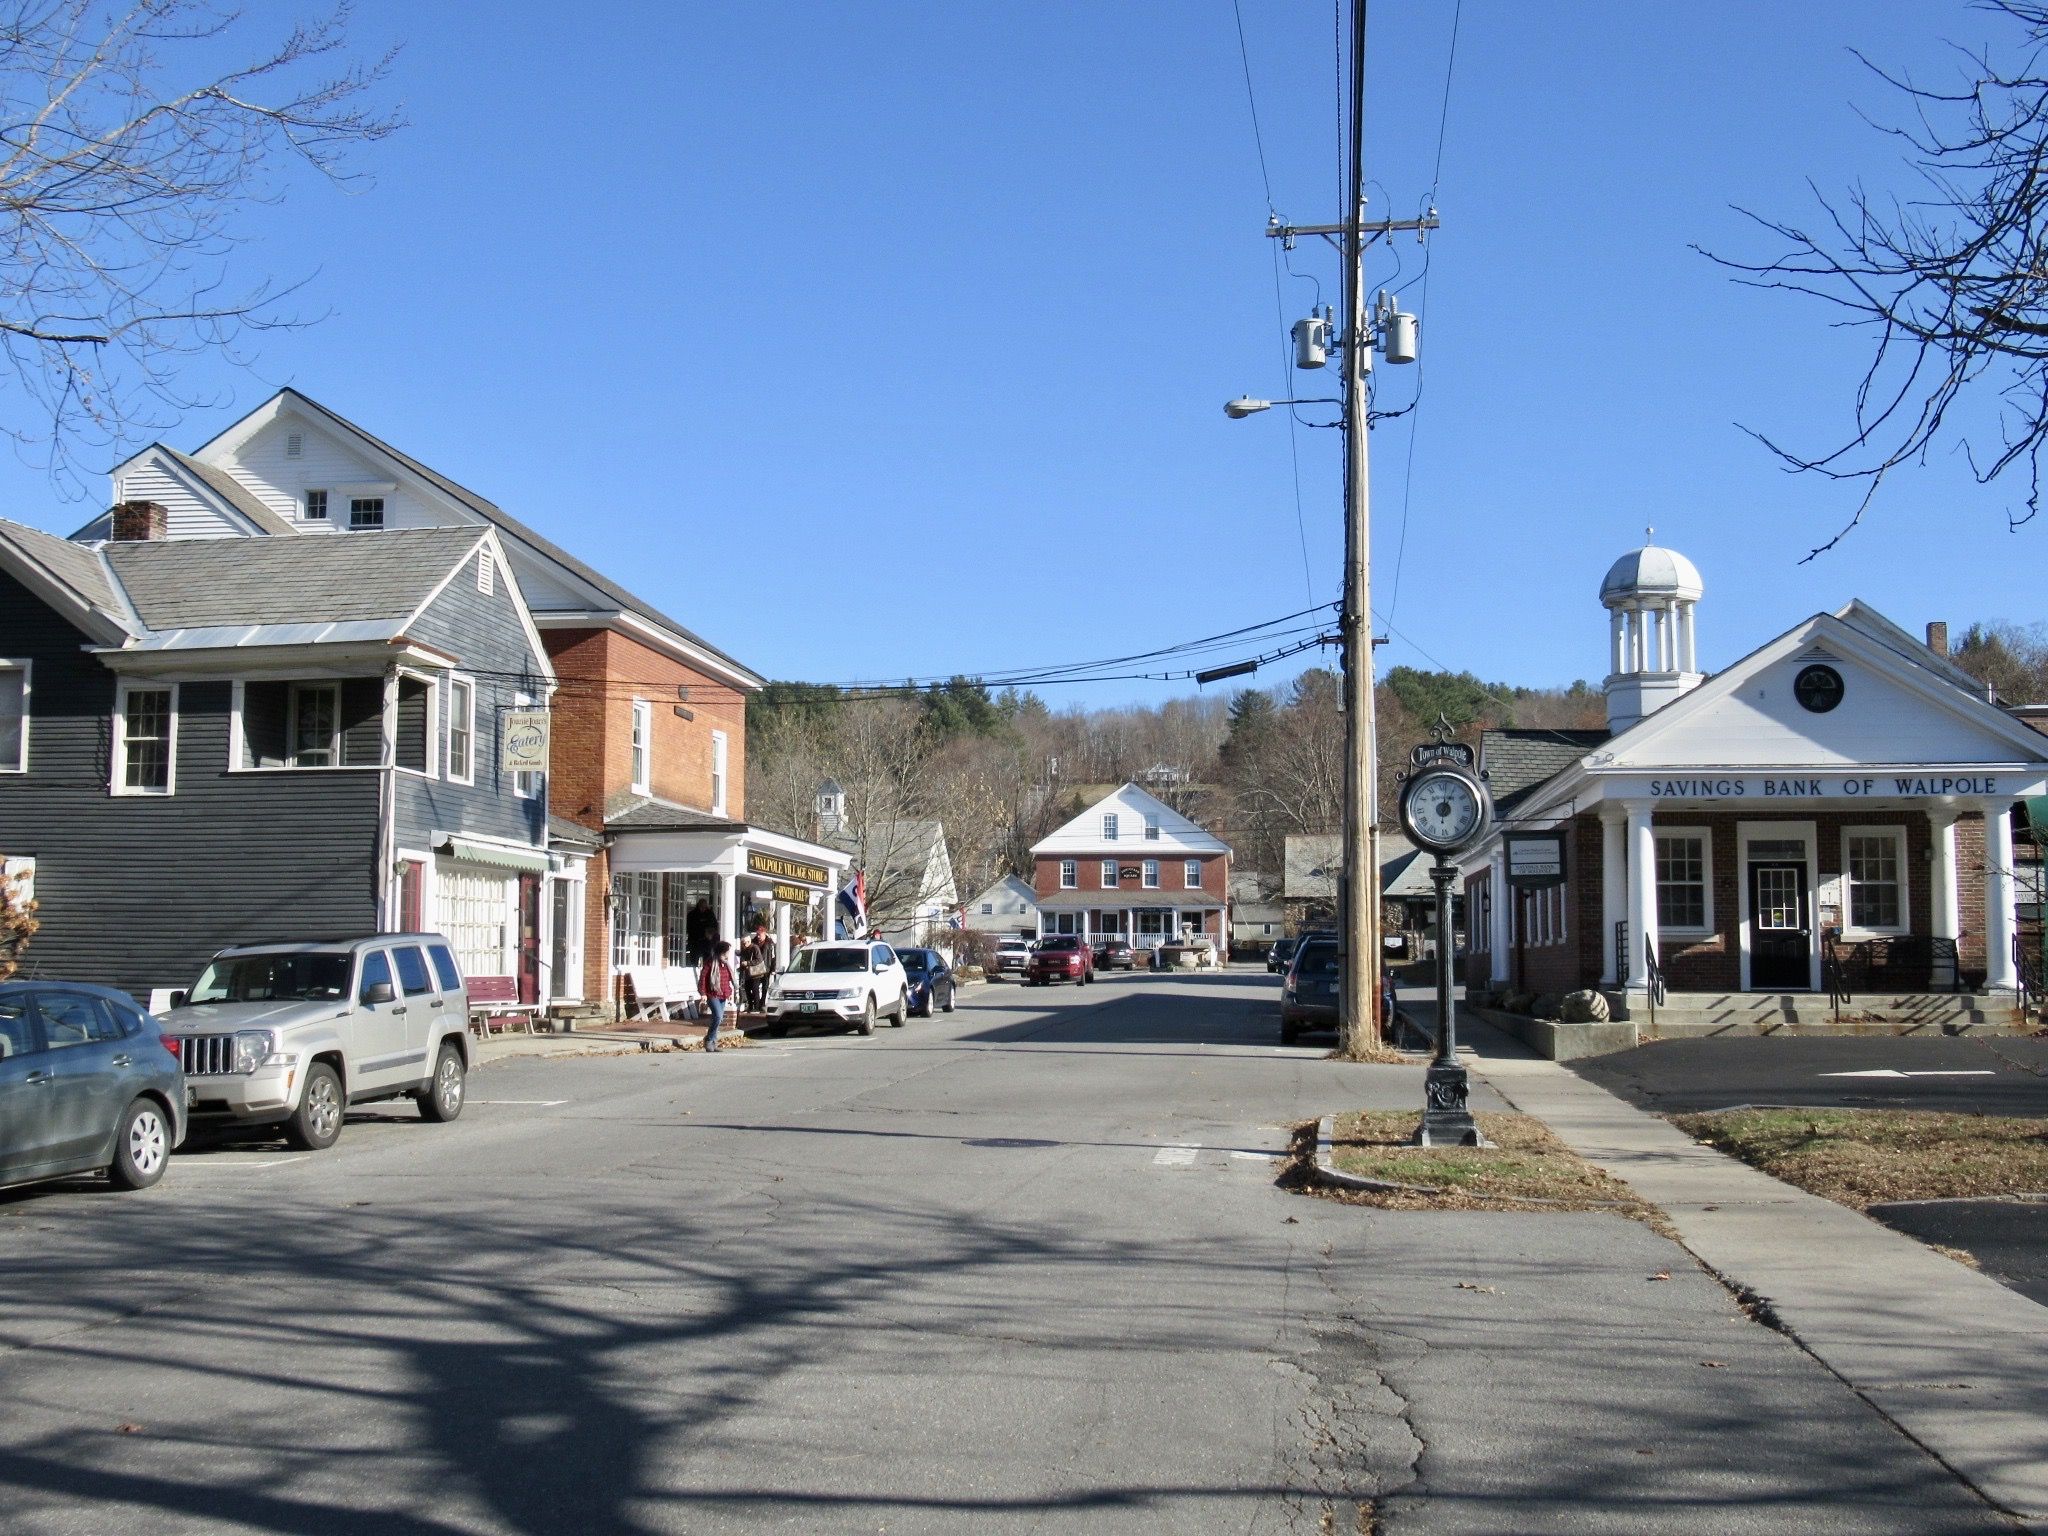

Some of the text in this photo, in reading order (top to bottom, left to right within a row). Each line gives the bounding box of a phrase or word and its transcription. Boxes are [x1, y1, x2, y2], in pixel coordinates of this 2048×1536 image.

[507, 735, 545, 754] Eatery
[1418, 746, 1467, 761] Town of Walpole
[1651, 778, 1996, 796] SAVINGS BANK OF WALPOLE
[754, 856, 824, 883] WALPOLE VILLAGE STORE
